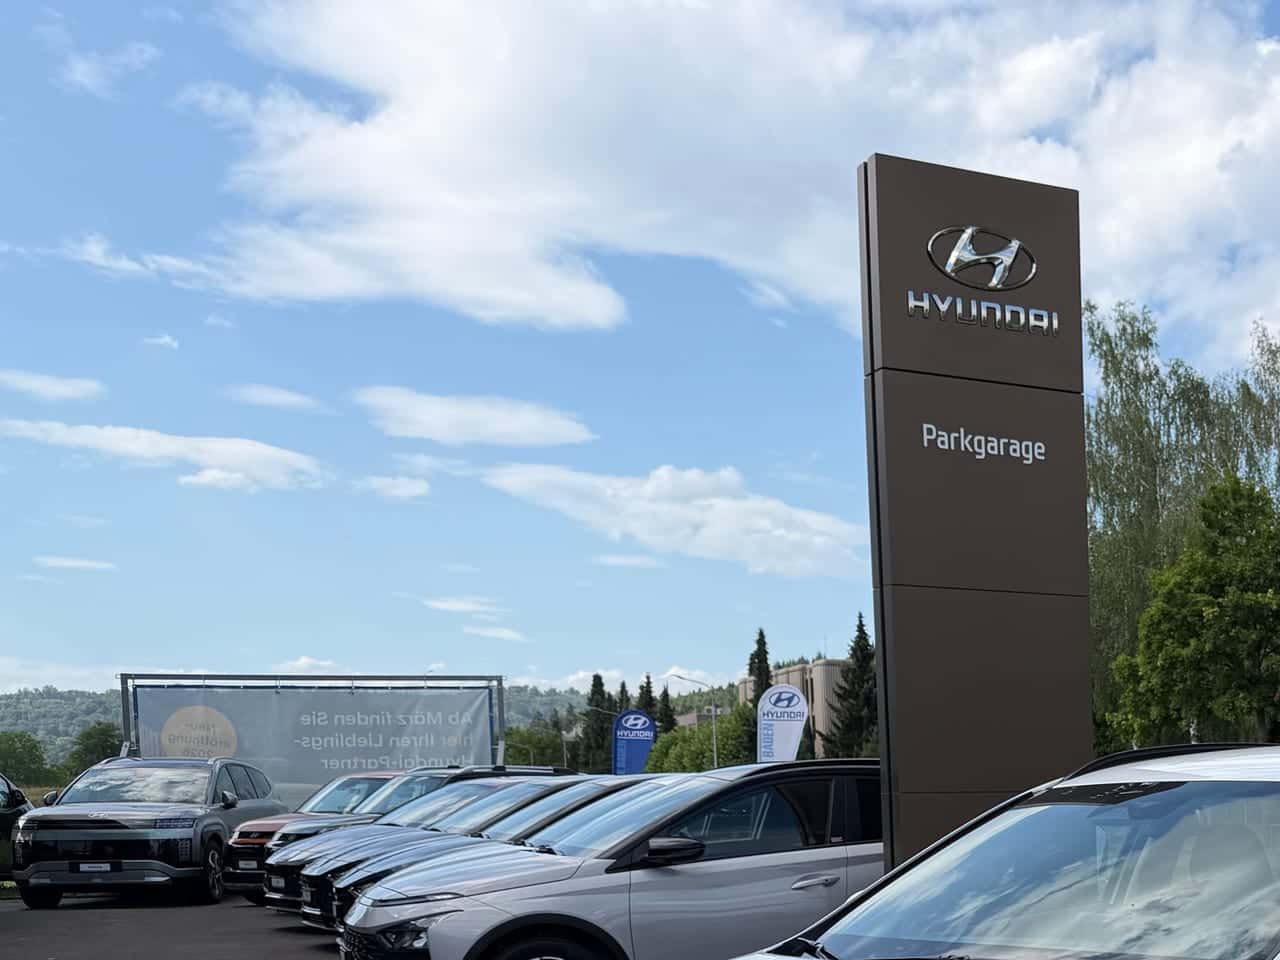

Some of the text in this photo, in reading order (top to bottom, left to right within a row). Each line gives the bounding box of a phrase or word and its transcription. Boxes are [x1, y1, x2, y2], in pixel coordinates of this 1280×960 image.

[908, 290, 1059, 338] HYUNDAI
[922, 423, 1046, 465] Parkgarage
[762, 711, 805, 721] HYUNDAI
[616, 730, 653, 738] HYUNDAI
